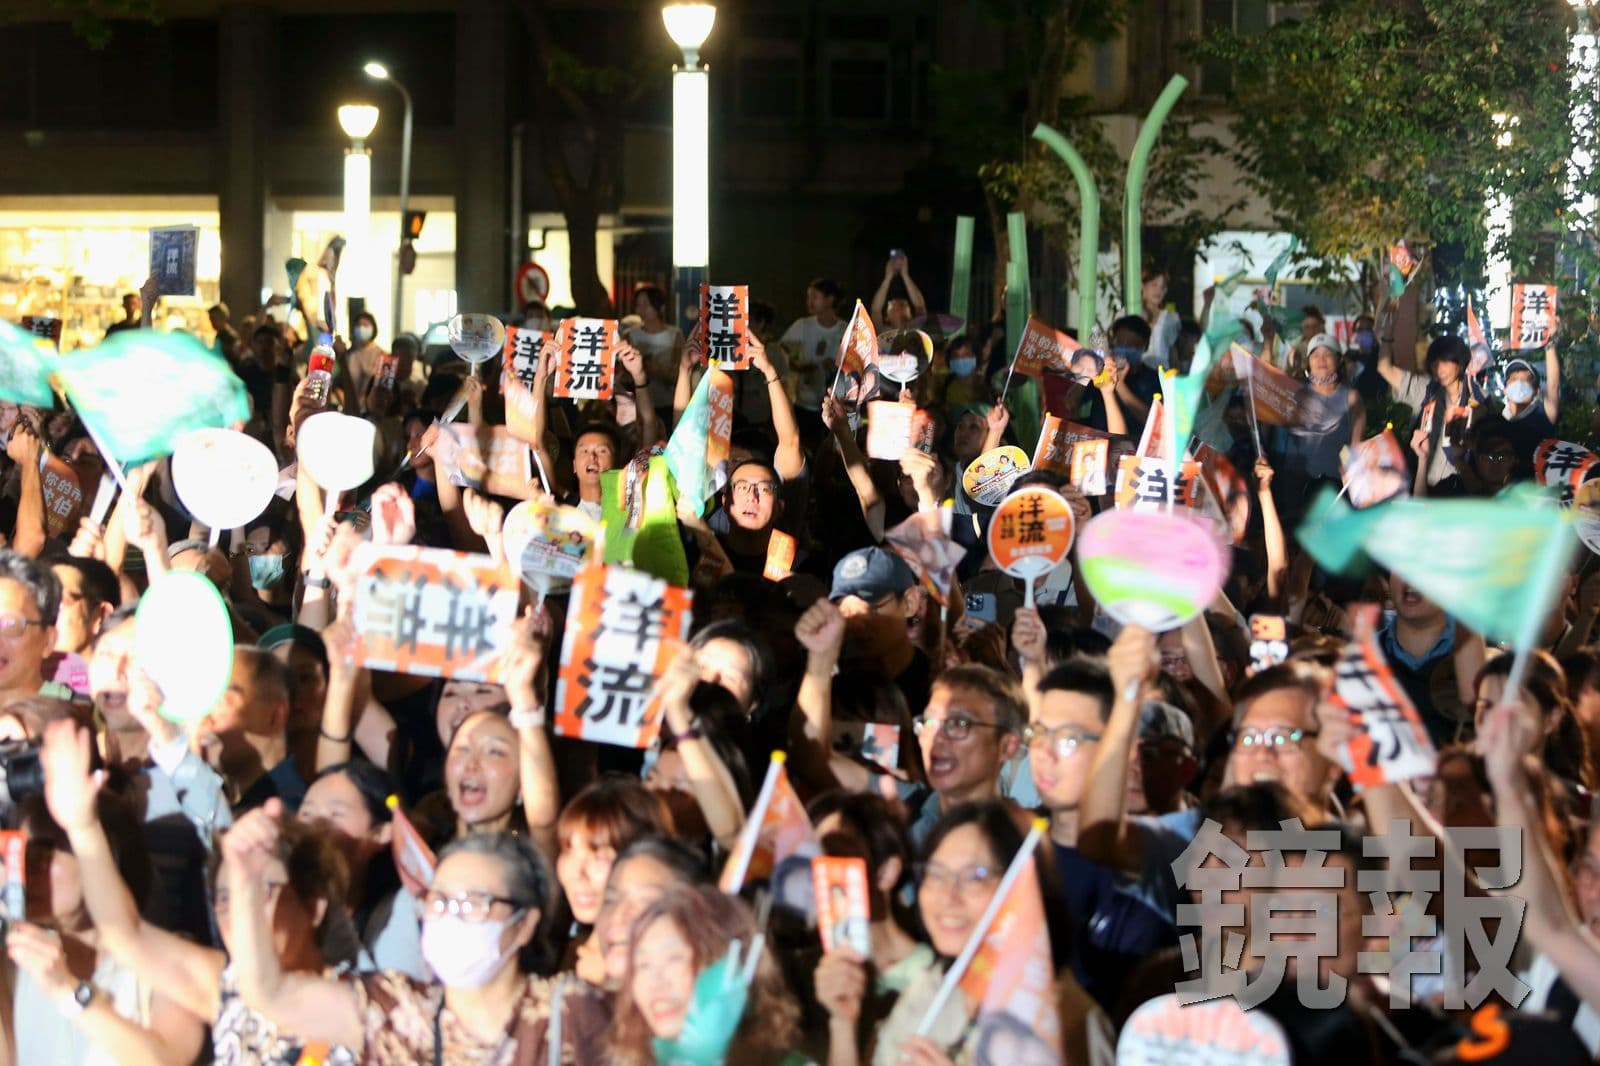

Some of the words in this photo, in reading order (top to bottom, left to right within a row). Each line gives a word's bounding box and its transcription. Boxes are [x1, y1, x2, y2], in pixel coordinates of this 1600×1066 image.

[706, 293, 742, 363] 洋流
[1517, 291, 1551, 342] 洋流
[565, 326, 609, 391] 洋流
[1018, 495, 1046, 544] 洋流
[367, 567, 498, 661] 洋流
[574, 591, 674, 728] 洋流
